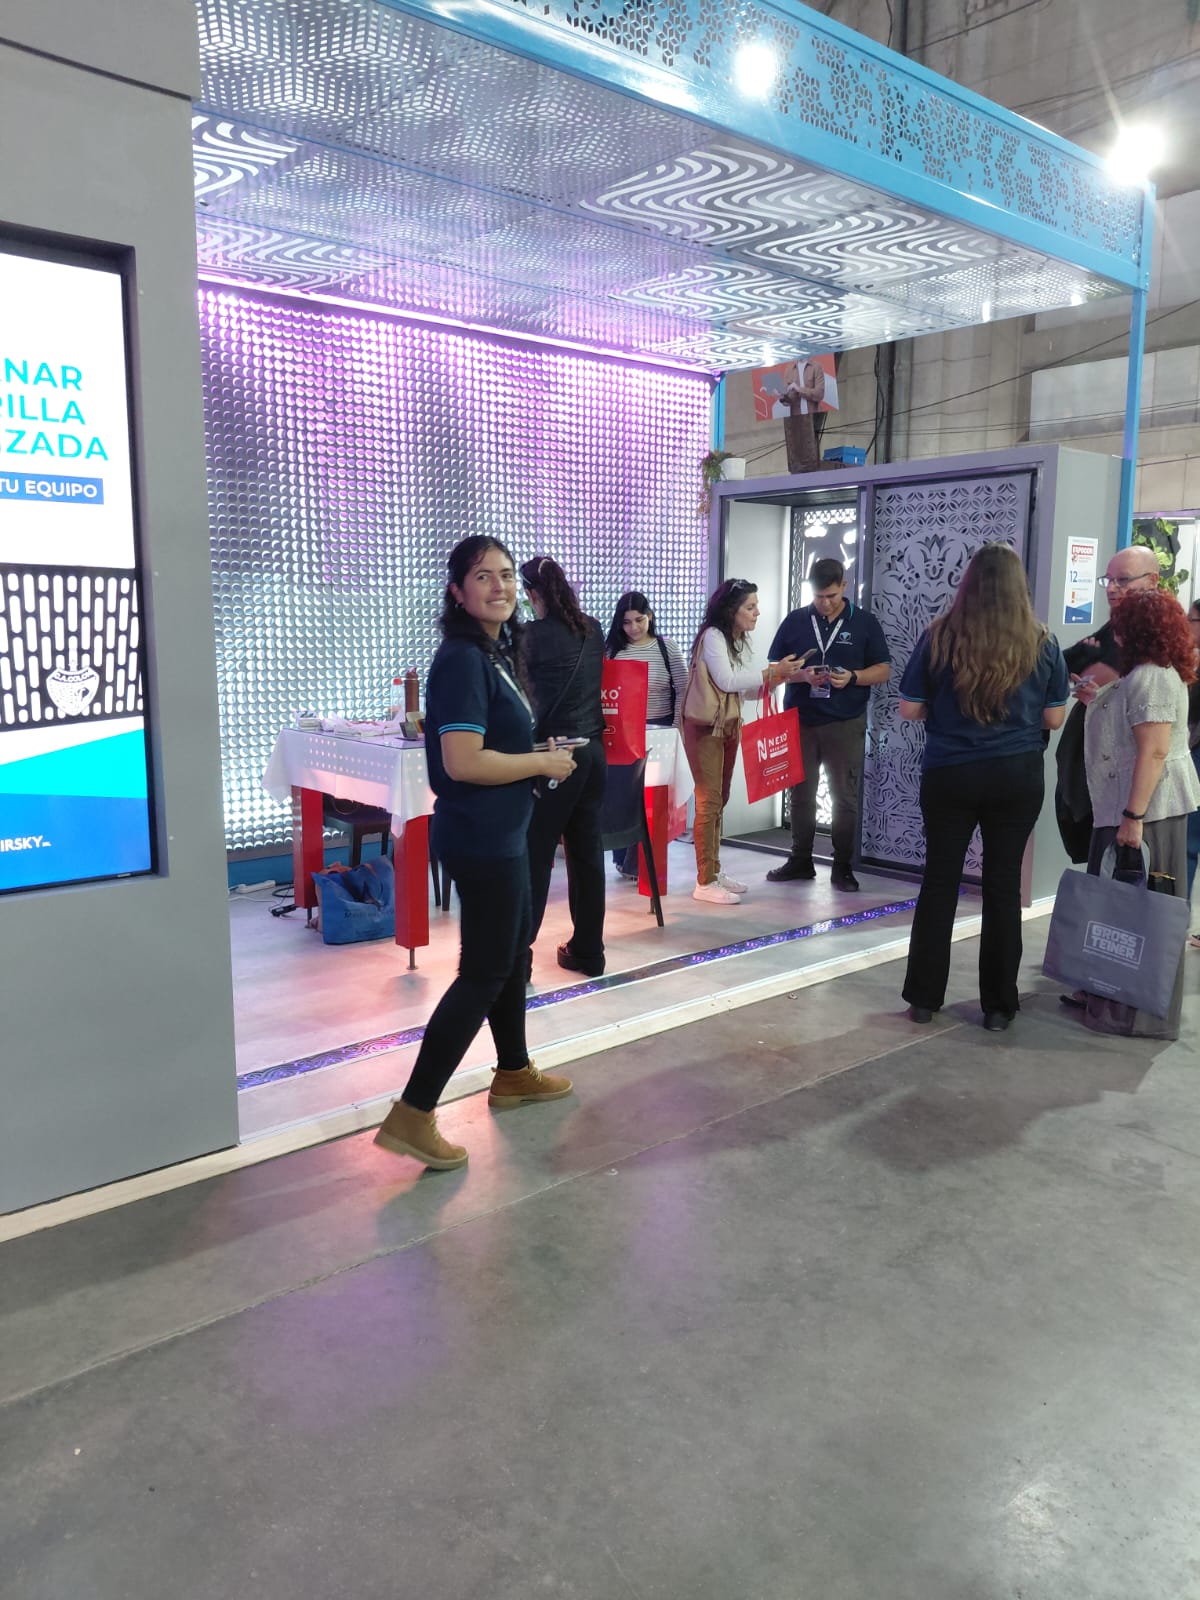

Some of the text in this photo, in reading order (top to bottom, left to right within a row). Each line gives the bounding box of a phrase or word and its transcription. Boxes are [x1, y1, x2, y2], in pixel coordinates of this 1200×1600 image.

[0, 357, 82, 391] NAR
[0, 393, 86, 425] ILLA
[0, 429, 109, 461] ZADA
[25, 480, 98, 498] EQUIPO
[1070, 570, 1078, 583] 12
[0, 835, 43, 852] IRSKY
[1091, 935, 1135, 960] TEINER
[1092, 924, 1137, 948] GROSS
